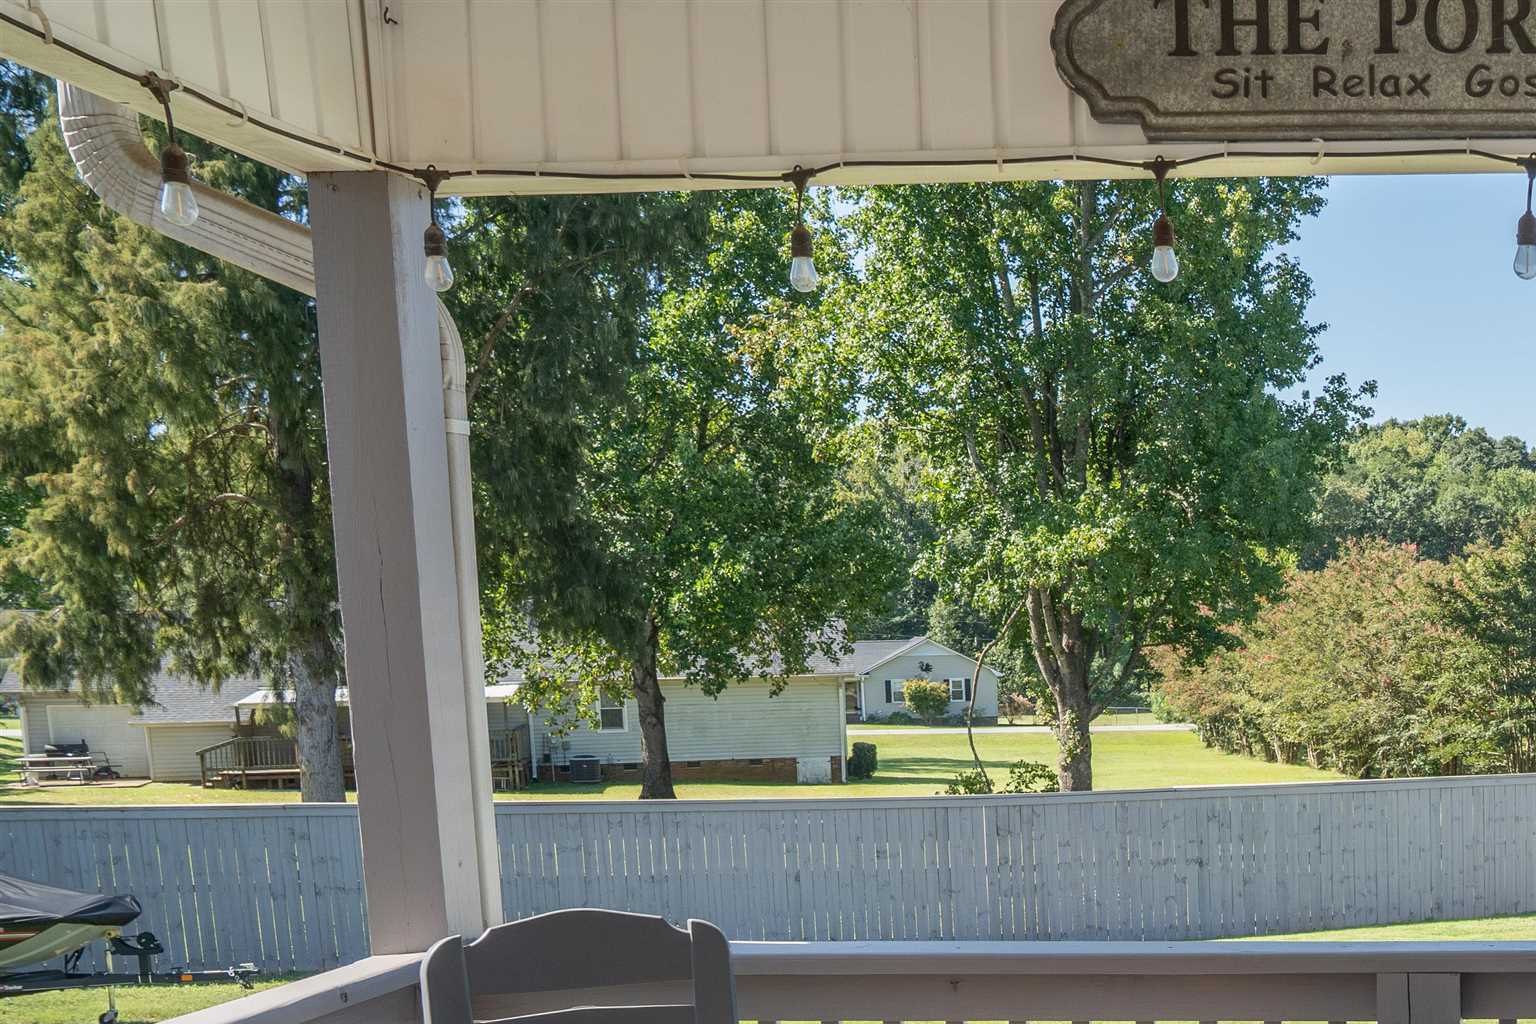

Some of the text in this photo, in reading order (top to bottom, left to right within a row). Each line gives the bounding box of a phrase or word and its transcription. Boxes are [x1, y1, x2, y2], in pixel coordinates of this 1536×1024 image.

[1153, 0, 1329, 56] THE
[1211, 67, 1274, 99] Sit
[1312, 64, 1432, 98] Relax
